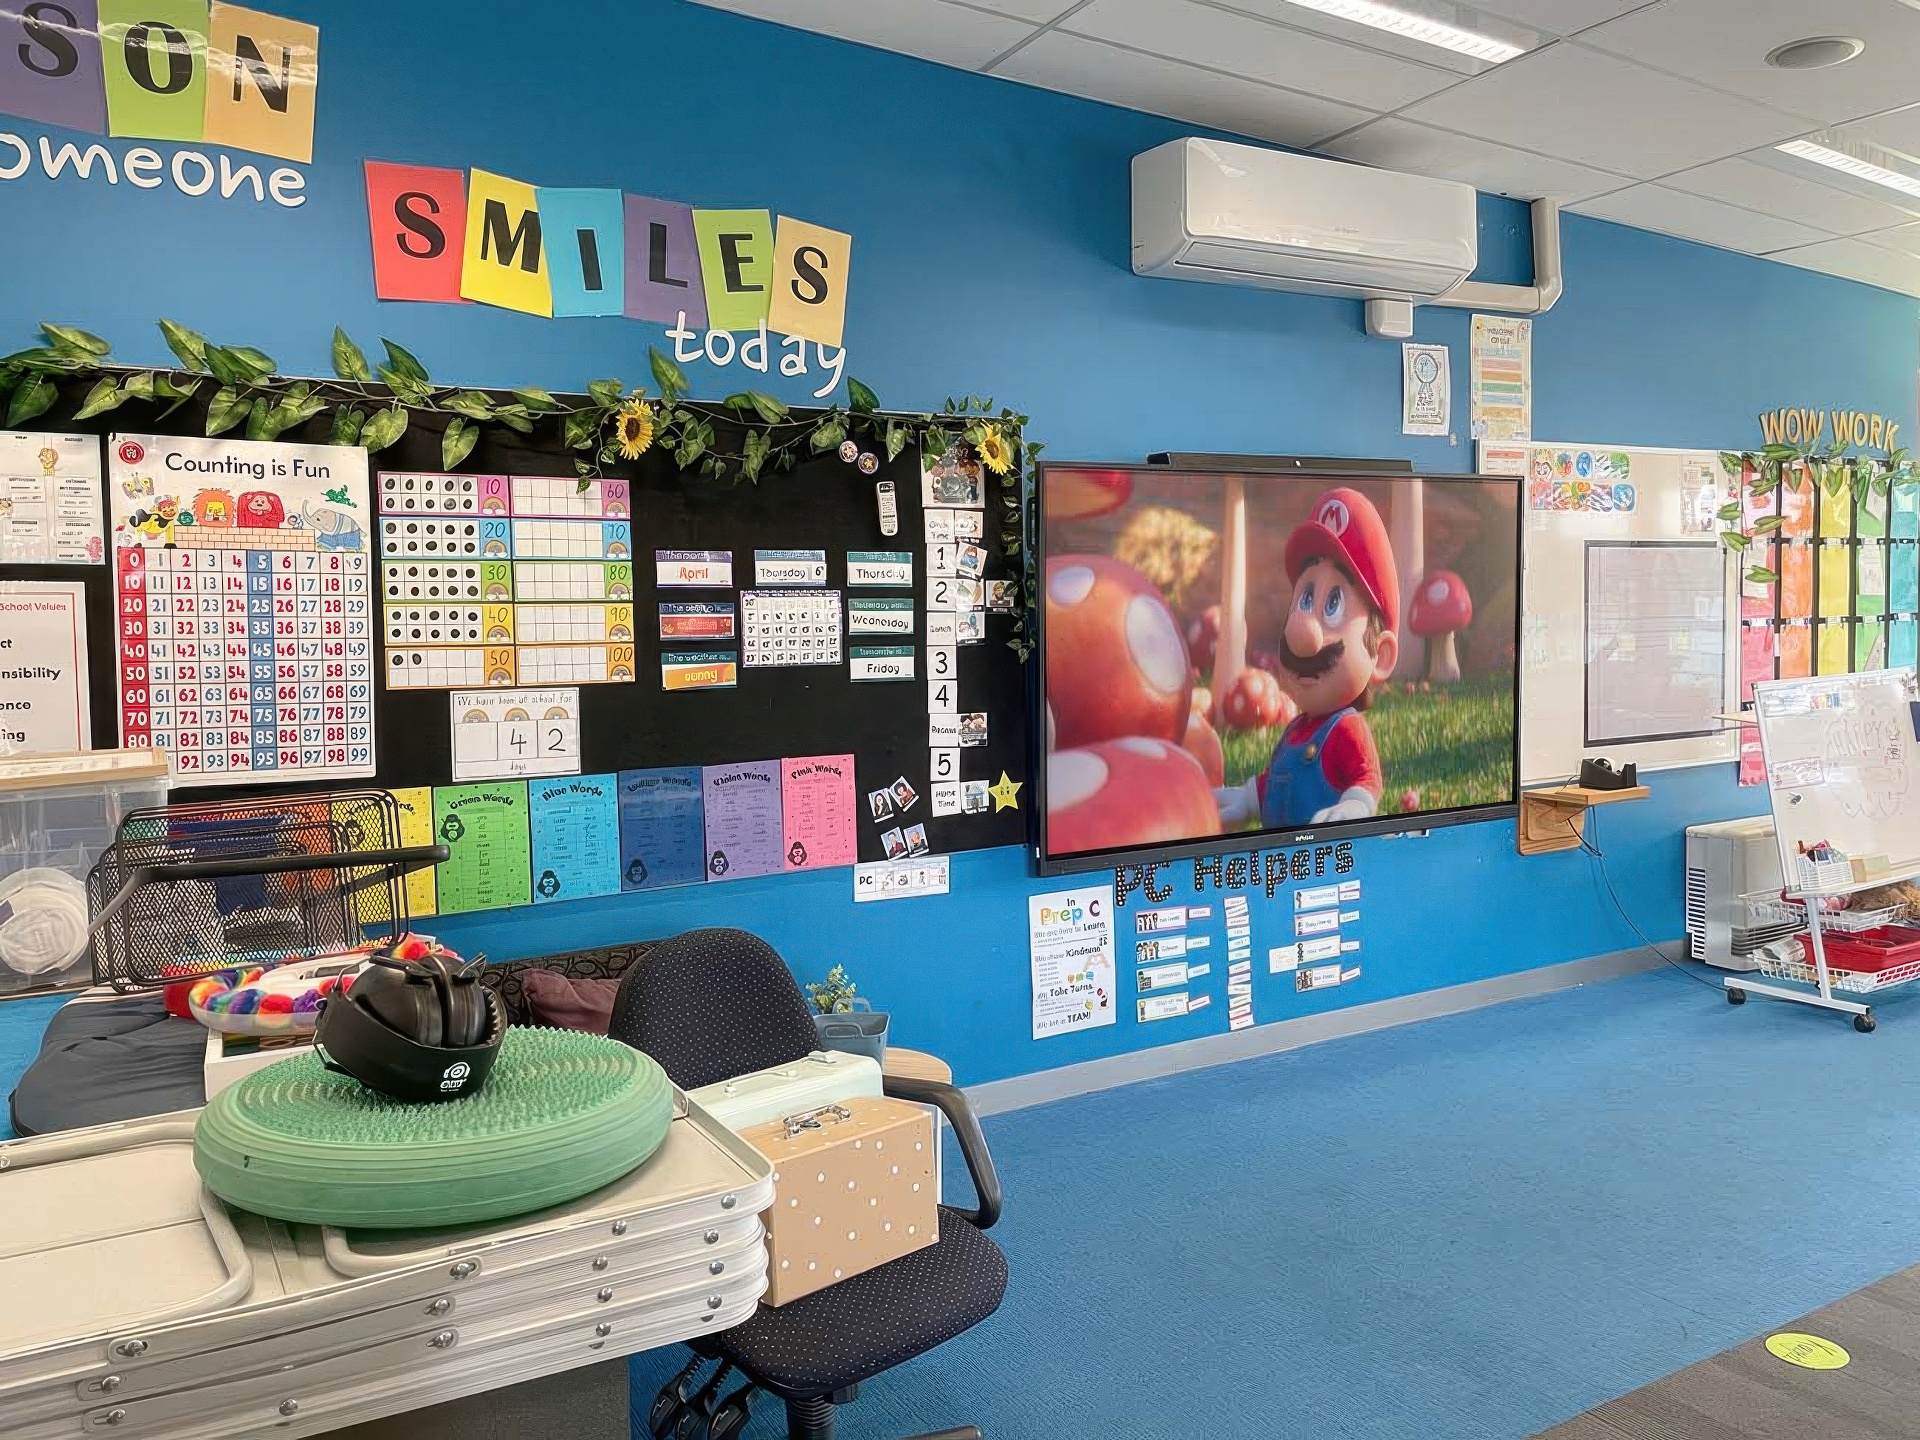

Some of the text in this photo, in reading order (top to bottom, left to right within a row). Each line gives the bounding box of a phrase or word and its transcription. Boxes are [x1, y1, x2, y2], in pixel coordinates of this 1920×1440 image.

[394, 191, 829, 305] SMILES
[664, 310, 847, 398] today
[1760, 408, 1899, 454] WOW WORK
[165, 452, 331, 479] Counting is Fun
[485, 478, 501, 495] 10
[607, 483, 624, 499] 60
[484, 522, 506, 538] 20
[129, 553, 139, 567] 0
[182, 554, 191, 567] 2
[208, 554, 215, 567] 3
[233, 555, 242, 568] 4
[258, 555, 267, 569] 5
[282, 556, 291, 569] 6
[306, 556, 315, 569] 7
[330, 556, 339, 570] 8
[354, 557, 362, 569] 9
[936, 546, 946, 570] 1
[487, 565, 507, 581] 30
[610, 565, 627, 580] 80
[679, 566, 709, 581] April
[125, 574, 362, 592] 10 11 12 13 14 15 16 17 18 19
[935, 581, 948, 604] 2
[124, 598, 364, 613] 20 21 22 23 24 25 26 27 28 29
[488, 607, 508, 623] 40
[610, 607, 628, 622] 90
[125, 621, 364, 635] 30 31 32 33 34 35 36 37 38 39
[124, 642, 365, 658] 40 41 42 43 44 45 46 47 48 49
[491, 650, 509, 666] 50
[609, 647, 632, 663] 100
[867, 663, 900, 675] Friday
[935, 651, 948, 674] 3
[126, 664, 366, 680] 50 51 52 53 54 55 56 57 58 59
[126, 685, 366, 703] 60 61 62 63 64 65 66 67 68 69
[935, 684, 950, 708] 4
[127, 706, 366, 726] 70 71 72 73 74 75 76 77 78 79
[127, 727, 367, 748] 80 81 82 83 84 85 86 87 88 89
[181, 748, 368, 769] 92 93 94 95 96 97 98 99
[937, 753, 951, 776] 5
[815, 765, 843, 782] Words
[542, 783, 603, 801] Blue Words
[450, 793, 514, 810] Green Words
[859, 876, 873, 885] PC
[1115, 842, 1354, 907] PC Helpers
[1067, 898, 1076, 907] In
[1040, 900, 1100, 925] Prep C
